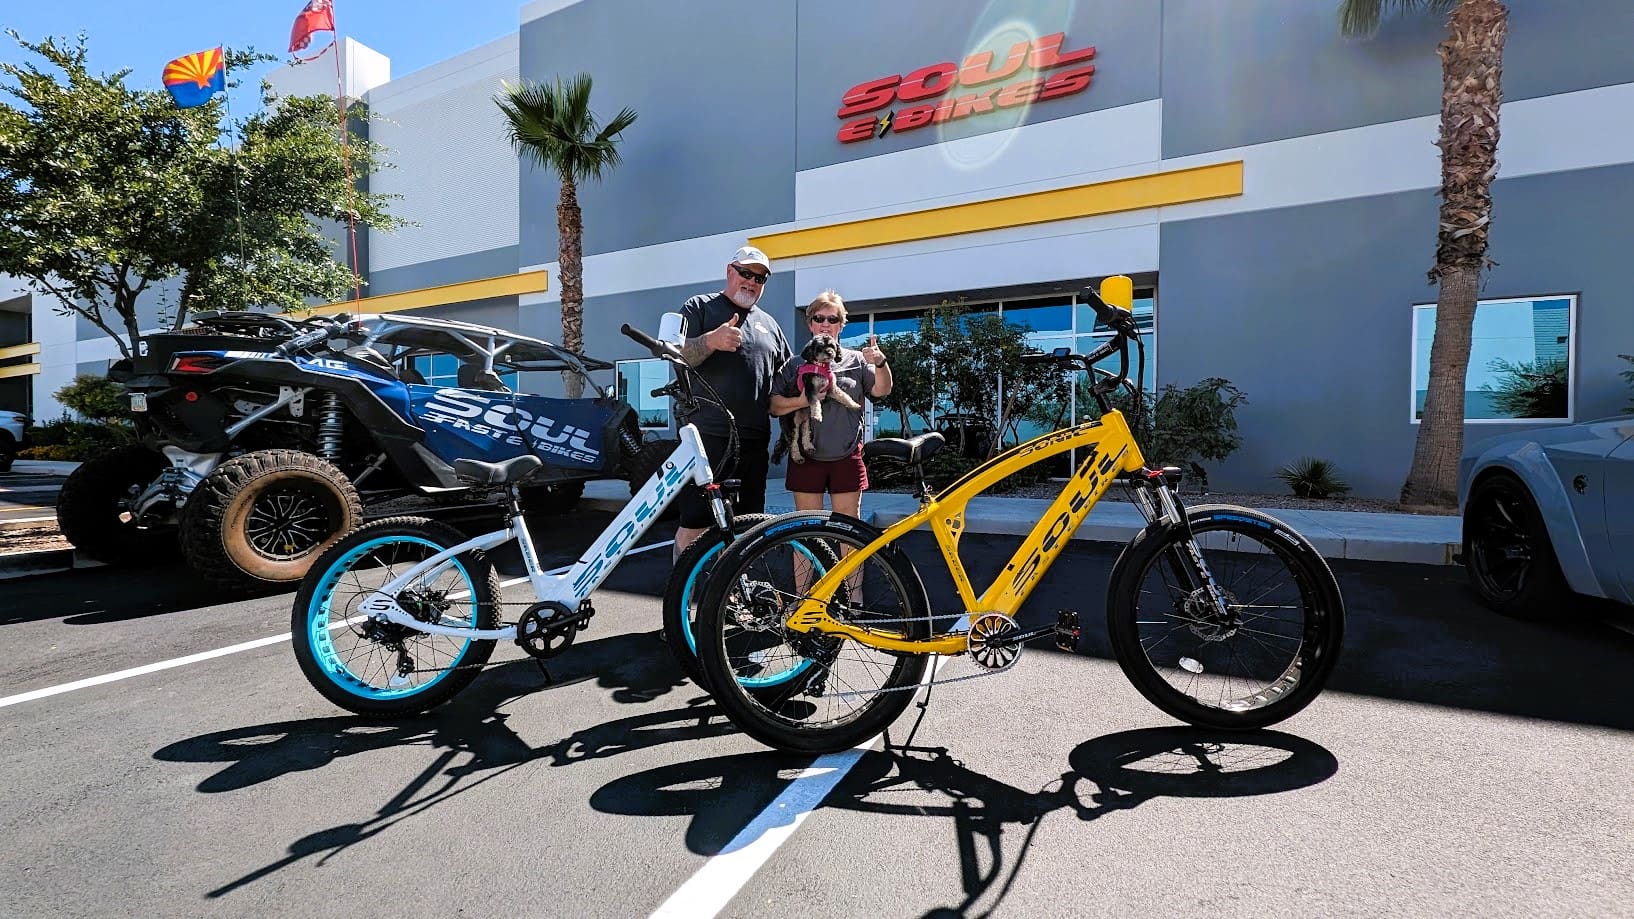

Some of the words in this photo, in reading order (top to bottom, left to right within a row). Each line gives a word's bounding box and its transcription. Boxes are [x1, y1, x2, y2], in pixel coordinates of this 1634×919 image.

[837, 32, 1096, 119] SOUL
[892, 65, 1095, 133] BIKES
[419, 410, 508, 439] FAST
[536, 441, 597, 464] BIKES
[424, 388, 599, 455] SOUL
[1018, 428, 1089, 457] SONIC
[573, 456, 695, 598] SOUL
[1012, 443, 1128, 596] SOUL
